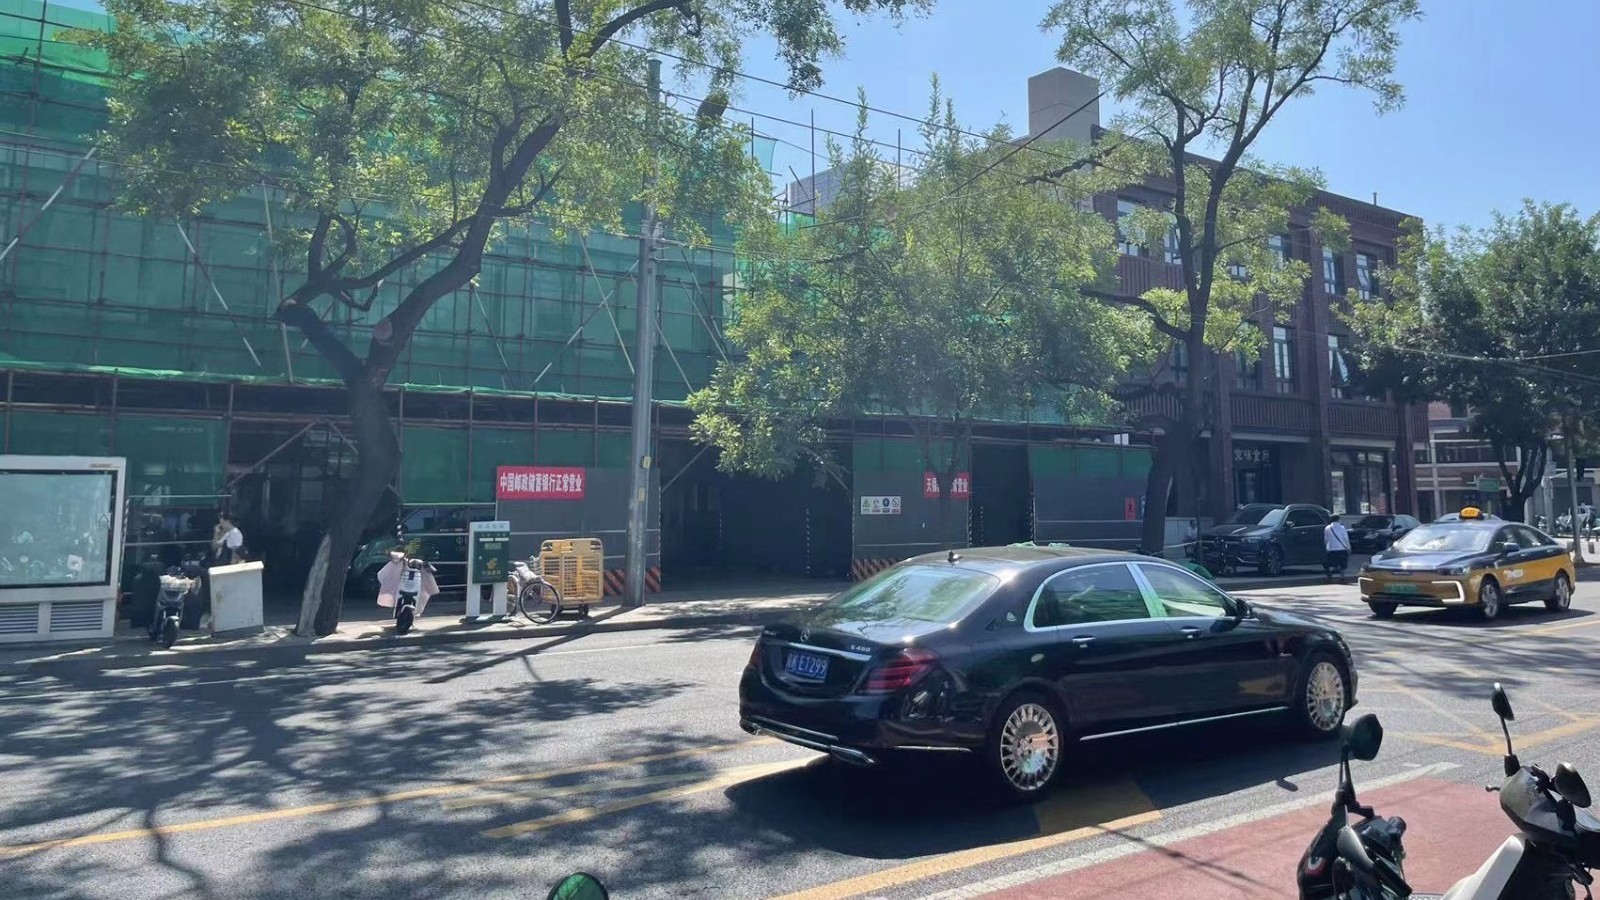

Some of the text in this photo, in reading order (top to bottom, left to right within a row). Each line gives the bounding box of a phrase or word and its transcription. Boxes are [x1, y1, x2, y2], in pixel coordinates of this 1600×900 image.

[500, 472, 582, 492] 中国邮政储蓄银行正常营业
